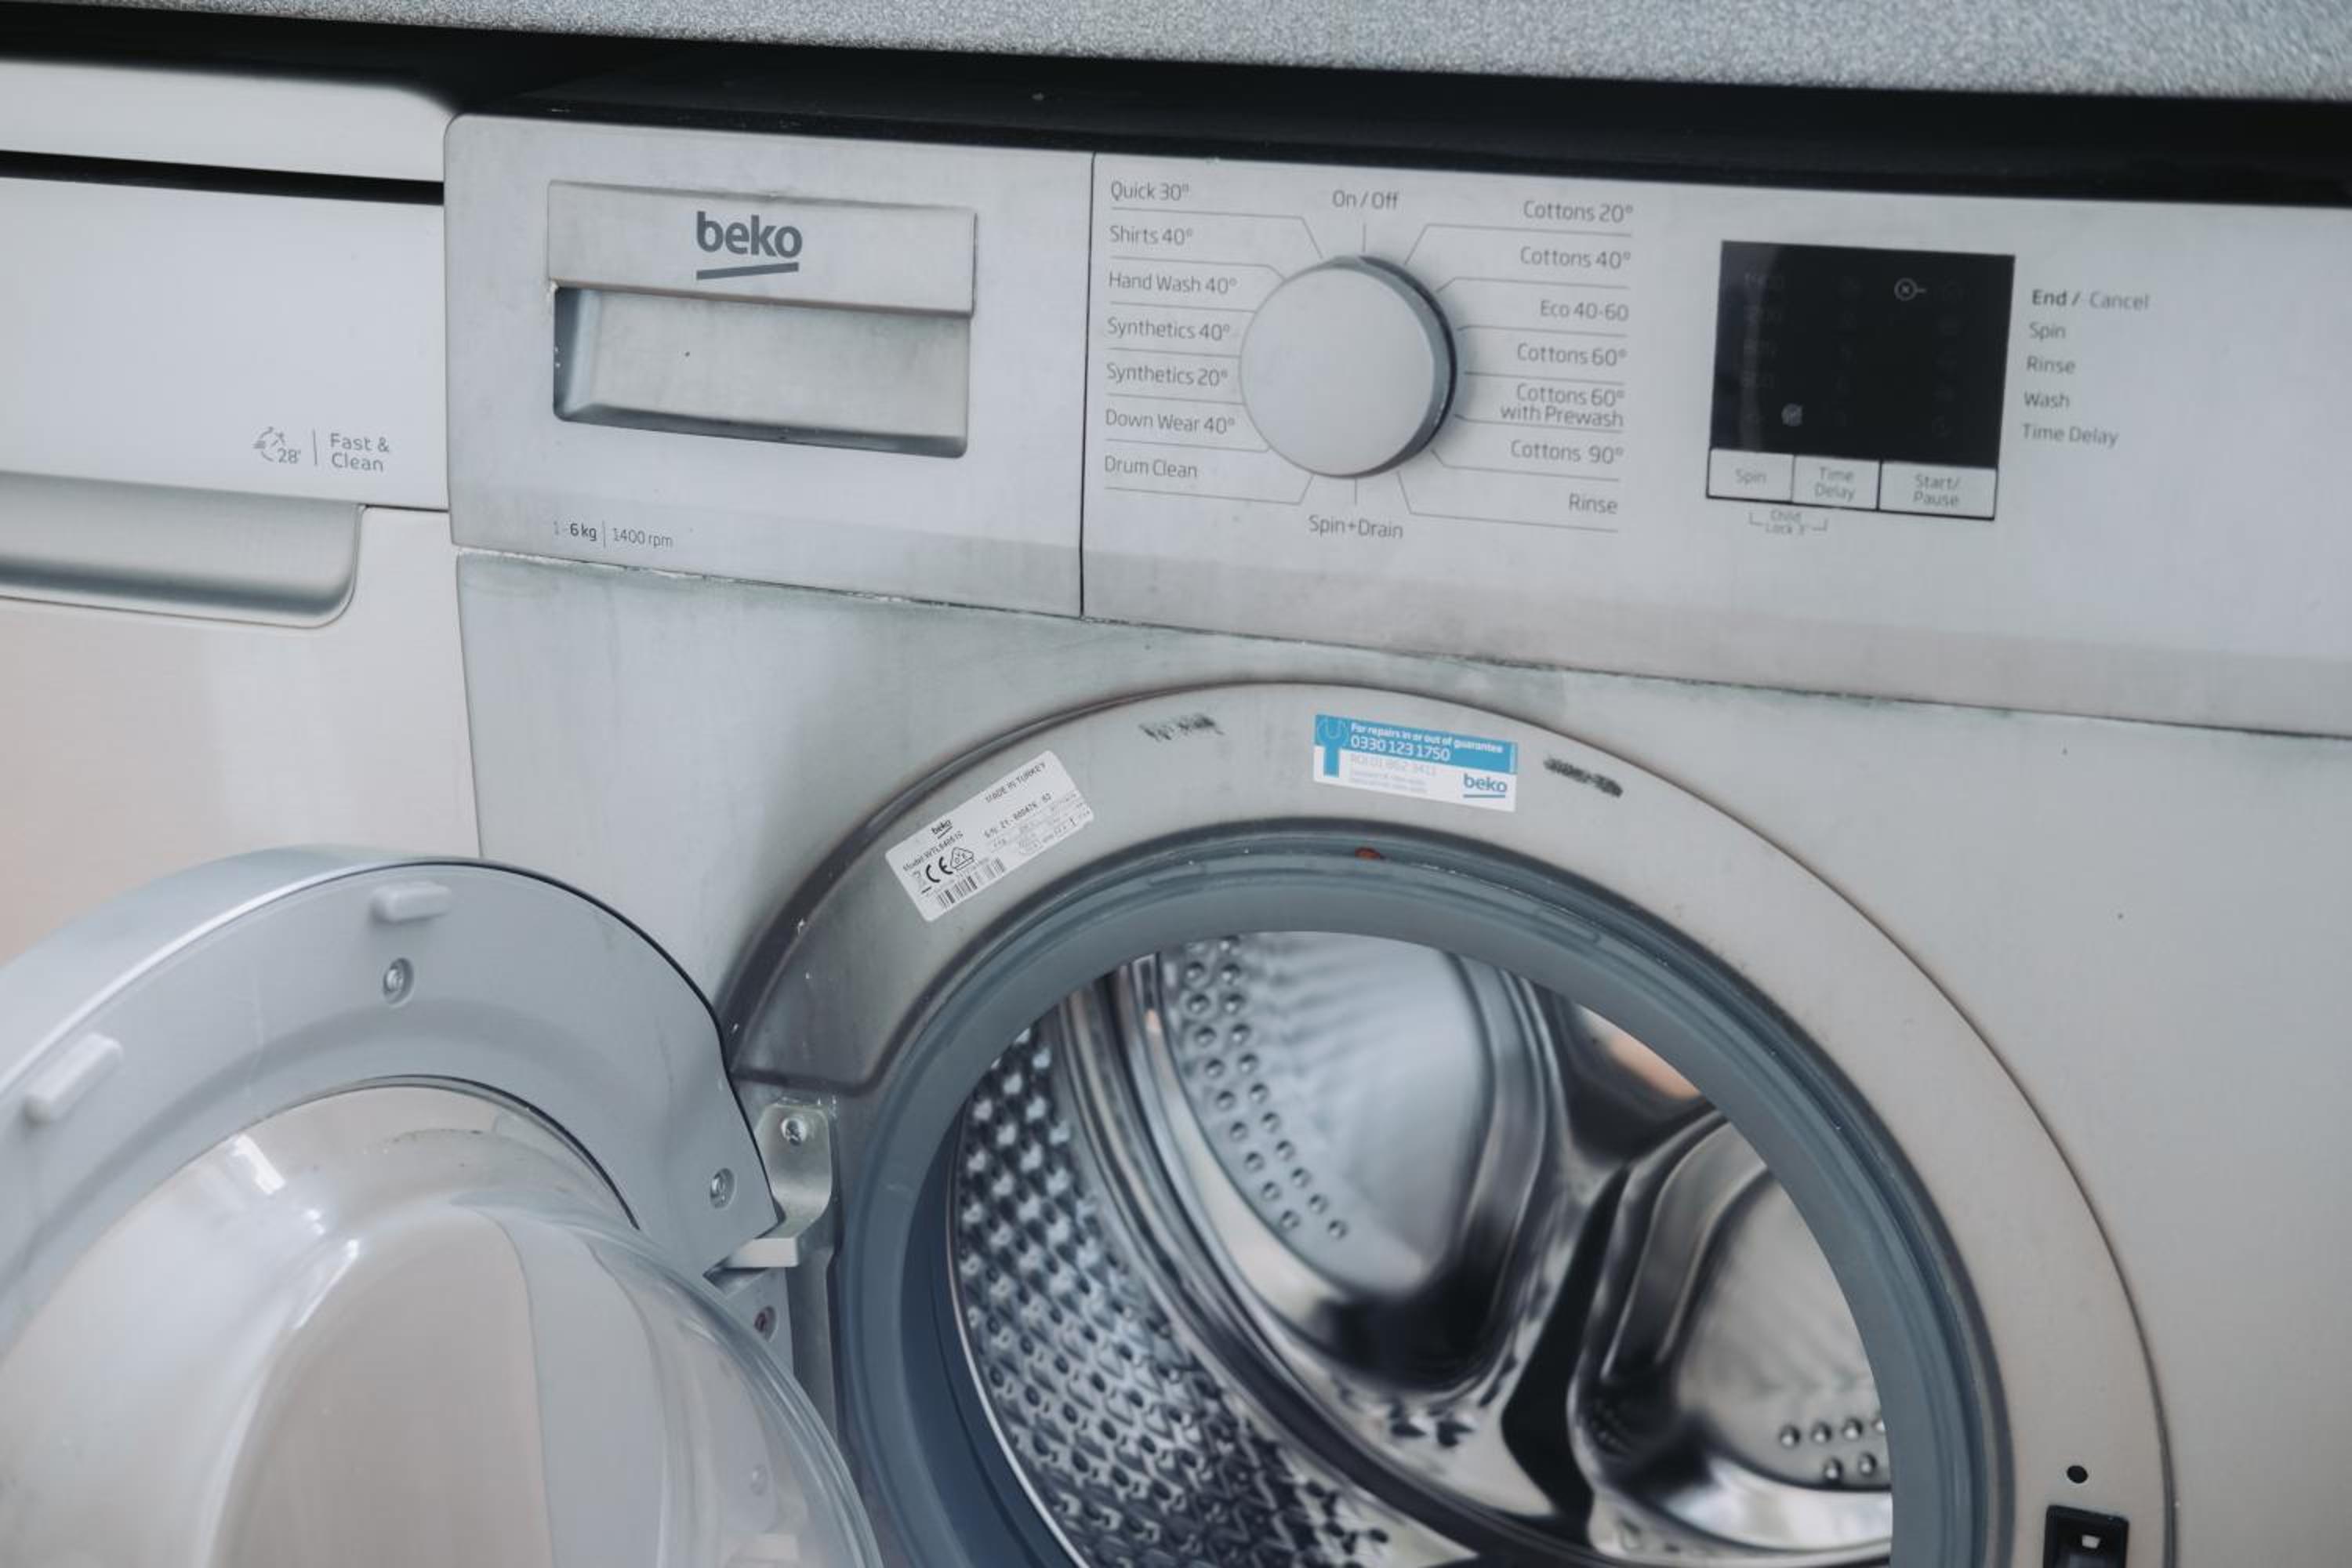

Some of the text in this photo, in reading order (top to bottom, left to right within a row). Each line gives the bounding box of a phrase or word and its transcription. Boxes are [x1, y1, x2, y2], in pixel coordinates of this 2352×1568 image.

[1111, 180, 1155, 201] Quick
[1333, 190, 1356, 208] On
[1371, 191, 1399, 209] Off
[1523, 200, 1595, 221] Cottons
[696, 211, 803, 259] beko
[1109, 226, 1158, 245] Shirts
[1520, 247, 1592, 267] Cottons
[1109, 272, 1152, 291] Hand
[1154, 274, 1200, 293] Wash
[2032, 289, 2067, 307] End
[2089, 293, 2150, 310] Cancel
[1540, 300, 1629, 321] Eco 40-60
[1107, 317, 1196, 340] Synthetics
[2029, 322, 2066, 341] Spin
[1517, 343, 1589, 365] Cottons
[1106, 363, 1194, 386] Synthetics
[2027, 355, 2075, 375] Rinse
[1516, 383, 1588, 405] Cottons
[2024, 391, 2070, 409] Wash
[1105, 409, 1152, 429] Down
[1157, 414, 1200, 433] Wear
[1501, 405, 1624, 427] with Prewash
[330, 432, 389, 452] Fast &
[2023, 423, 2118, 448] Time Delay
[331, 452, 383, 471] Clean
[1511, 440, 1581, 462] Cottons
[1105, 456, 1197, 478] Drum Clean
[1735, 469, 1767, 486] Spin
[1819, 467, 1854, 482] Time
[1814, 483, 1856, 502] Delay
[1913, 491, 1959, 507] Pause
[1569, 494, 1618, 514] Rinse
[581, 523, 597, 542] kg
[614, 527, 673, 548] 1400 rpm
[1308, 515, 1403, 539] Spin+Drain
[1351, 723, 1504, 753] For repairs in or out of guarantee
[1351, 735, 1450, 761] 0330 123 1750
[1464, 773, 1508, 793] beko
